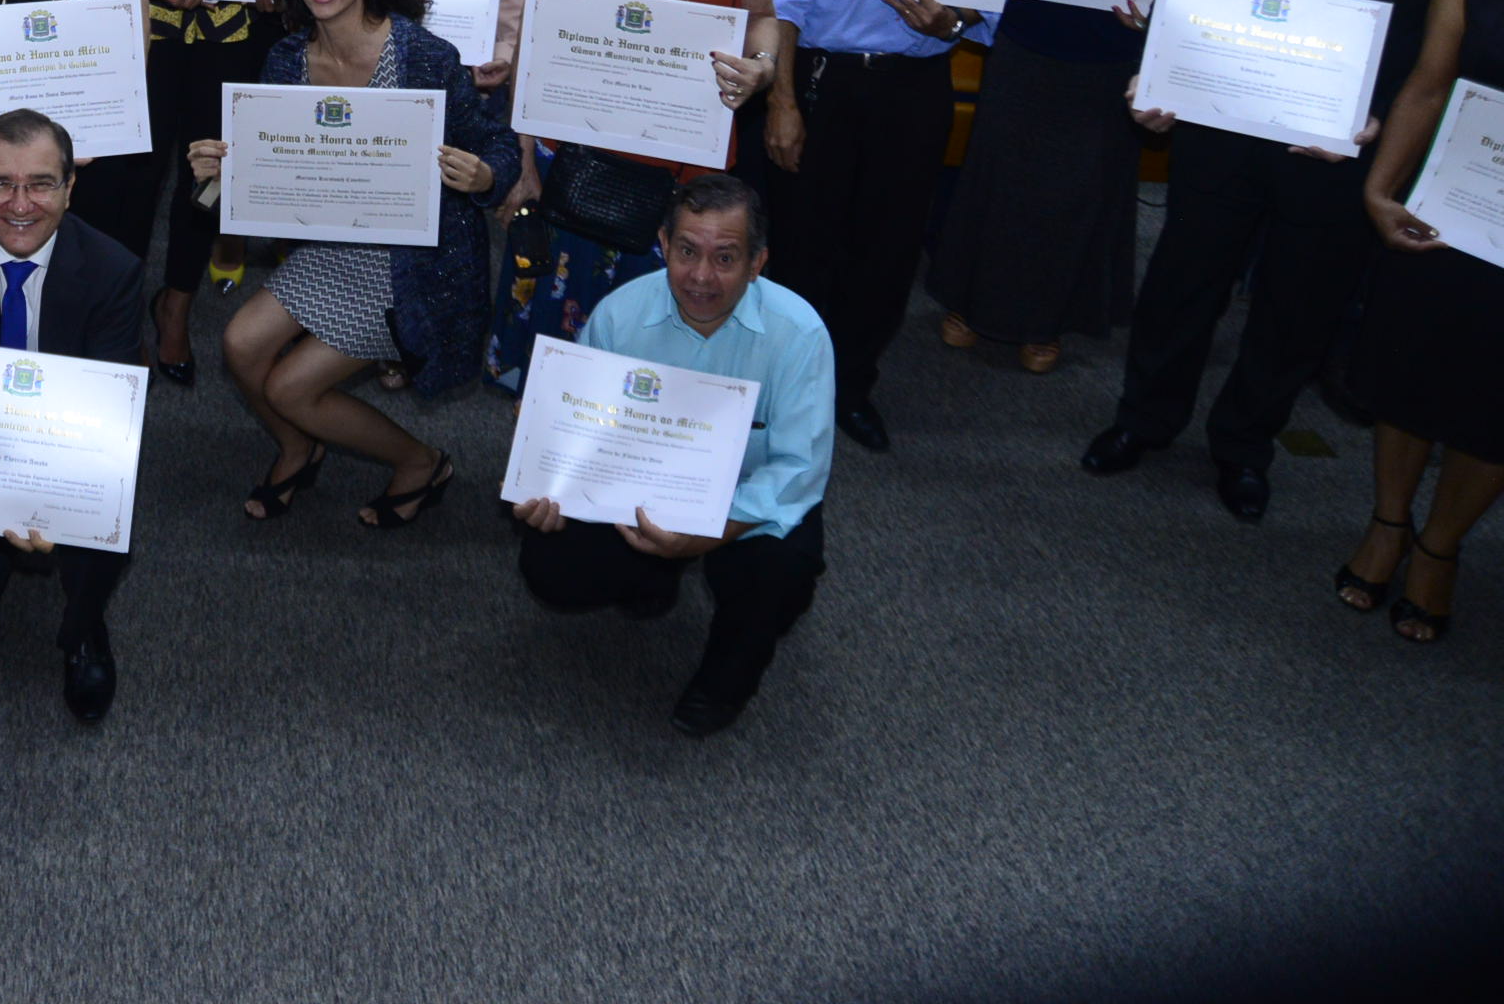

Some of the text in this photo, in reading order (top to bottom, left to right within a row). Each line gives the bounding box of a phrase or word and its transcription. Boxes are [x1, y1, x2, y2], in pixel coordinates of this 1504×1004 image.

[558, 29, 705, 61] Diploma de Honra ao Mérito
[258, 131, 408, 146] Diploma de Honra ao Mérito
